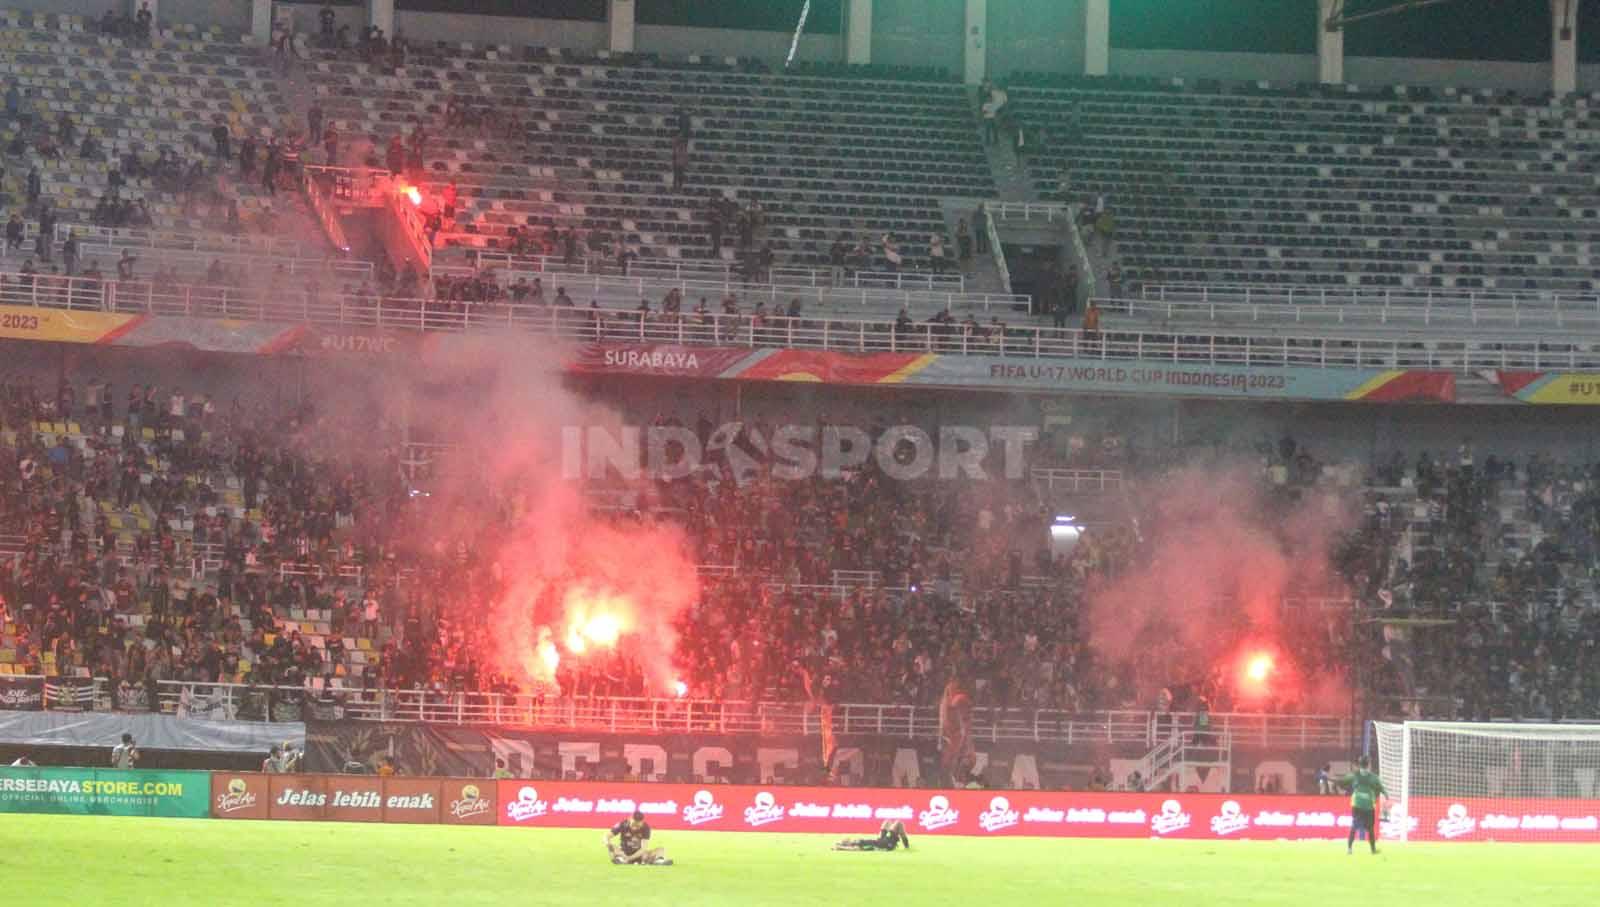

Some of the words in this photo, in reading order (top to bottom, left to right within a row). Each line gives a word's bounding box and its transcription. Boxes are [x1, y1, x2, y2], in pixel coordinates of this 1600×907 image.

[604, 349, 700, 369] SURABAYA
[989, 364, 1027, 378] FIFA
[1069, 367, 1128, 383] WORLD
[1130, 369, 1163, 384] CUP
[277, 788, 327, 807] Jelas
[332, 790, 381, 808] lebih
[386, 792, 434, 809] enak
